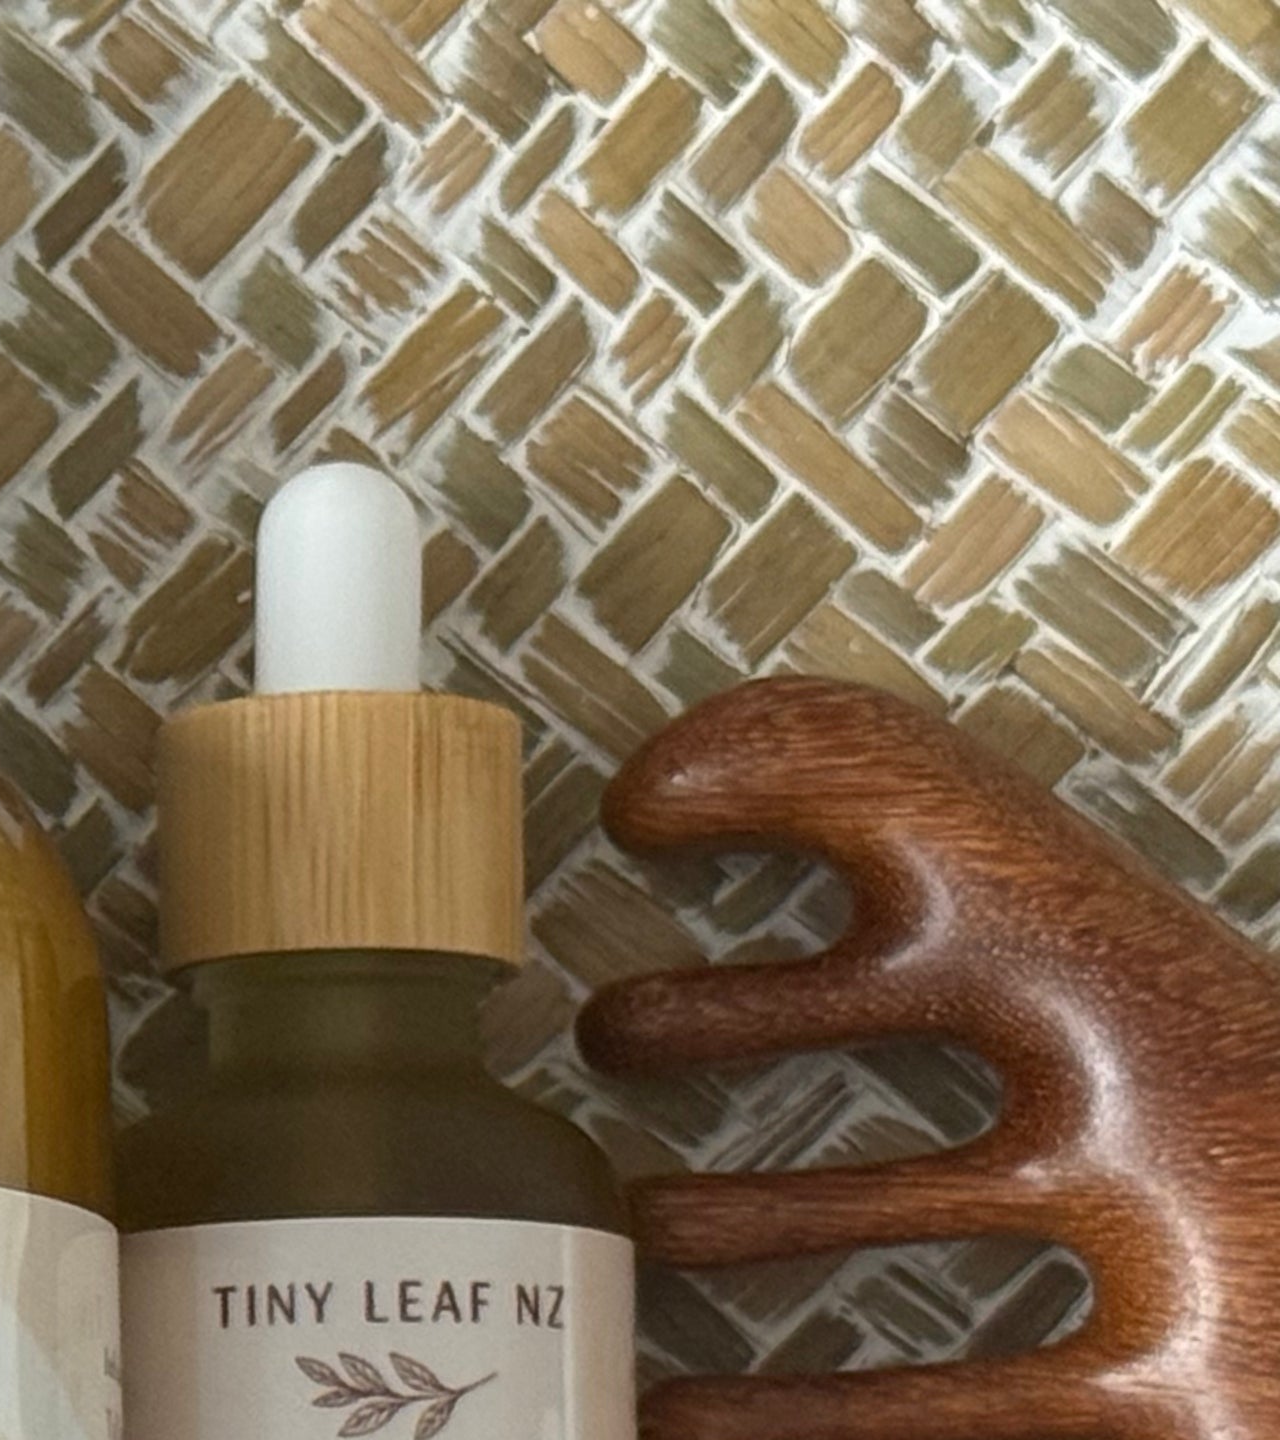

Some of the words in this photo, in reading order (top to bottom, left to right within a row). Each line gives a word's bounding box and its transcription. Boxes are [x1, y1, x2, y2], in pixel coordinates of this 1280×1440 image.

[211, 1280, 334, 1330] TINY
[364, 1279, 492, 1324] LEAF
[515, 1283, 565, 1331] NZ
